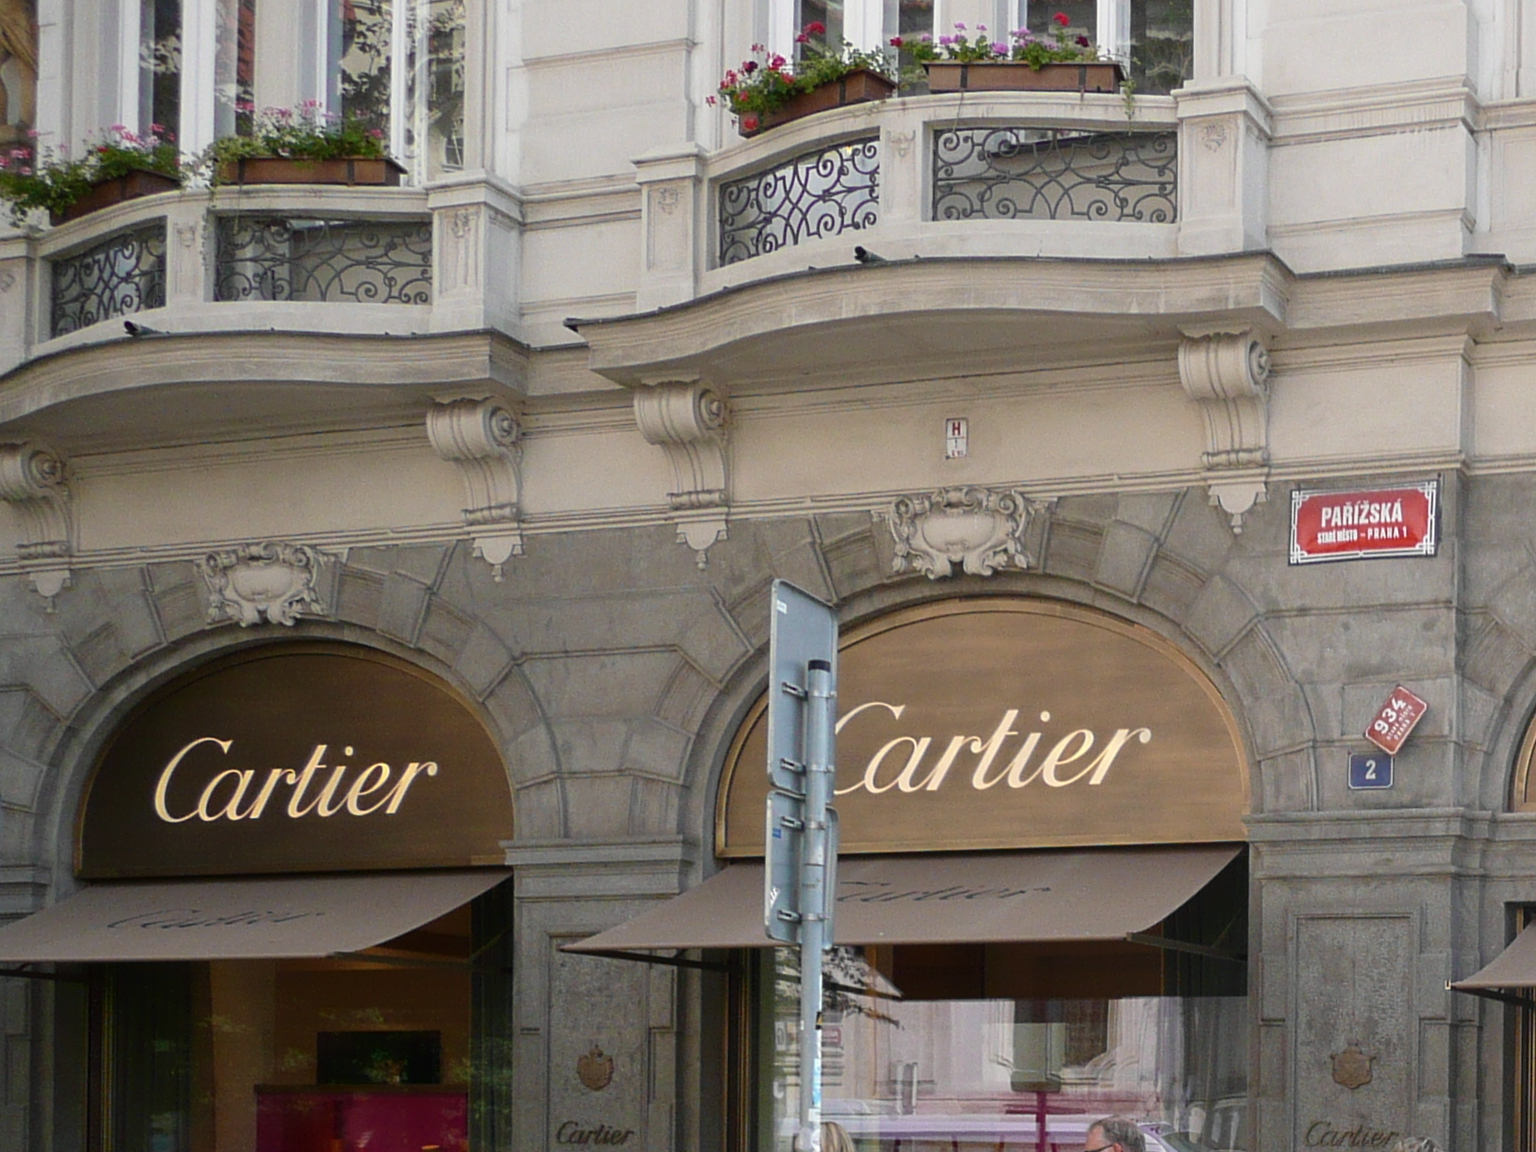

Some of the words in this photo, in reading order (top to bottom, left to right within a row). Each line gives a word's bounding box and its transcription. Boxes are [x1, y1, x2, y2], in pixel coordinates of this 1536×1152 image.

[952, 421, 961, 436] H
[1321, 498, 1403, 528] PAŘÍŽSKÁ
[1317, 529, 1336, 545] STARÉ
[1337, 528, 1358, 543] MĚSTO
[1367, 526, 1399, 540] PRAHA
[1402, 525, 1407, 538] 1
[1374, 698, 1407, 735] 934
[834, 701, 1152, 796] Cartier
[154, 736, 438, 824] Cartier
[1365, 760, 1376, 780] 2
[107, 908, 326, 930] Cartier
[556, 1120, 635, 1146] Cartier
[1305, 1120, 1401, 1148] Cartier
